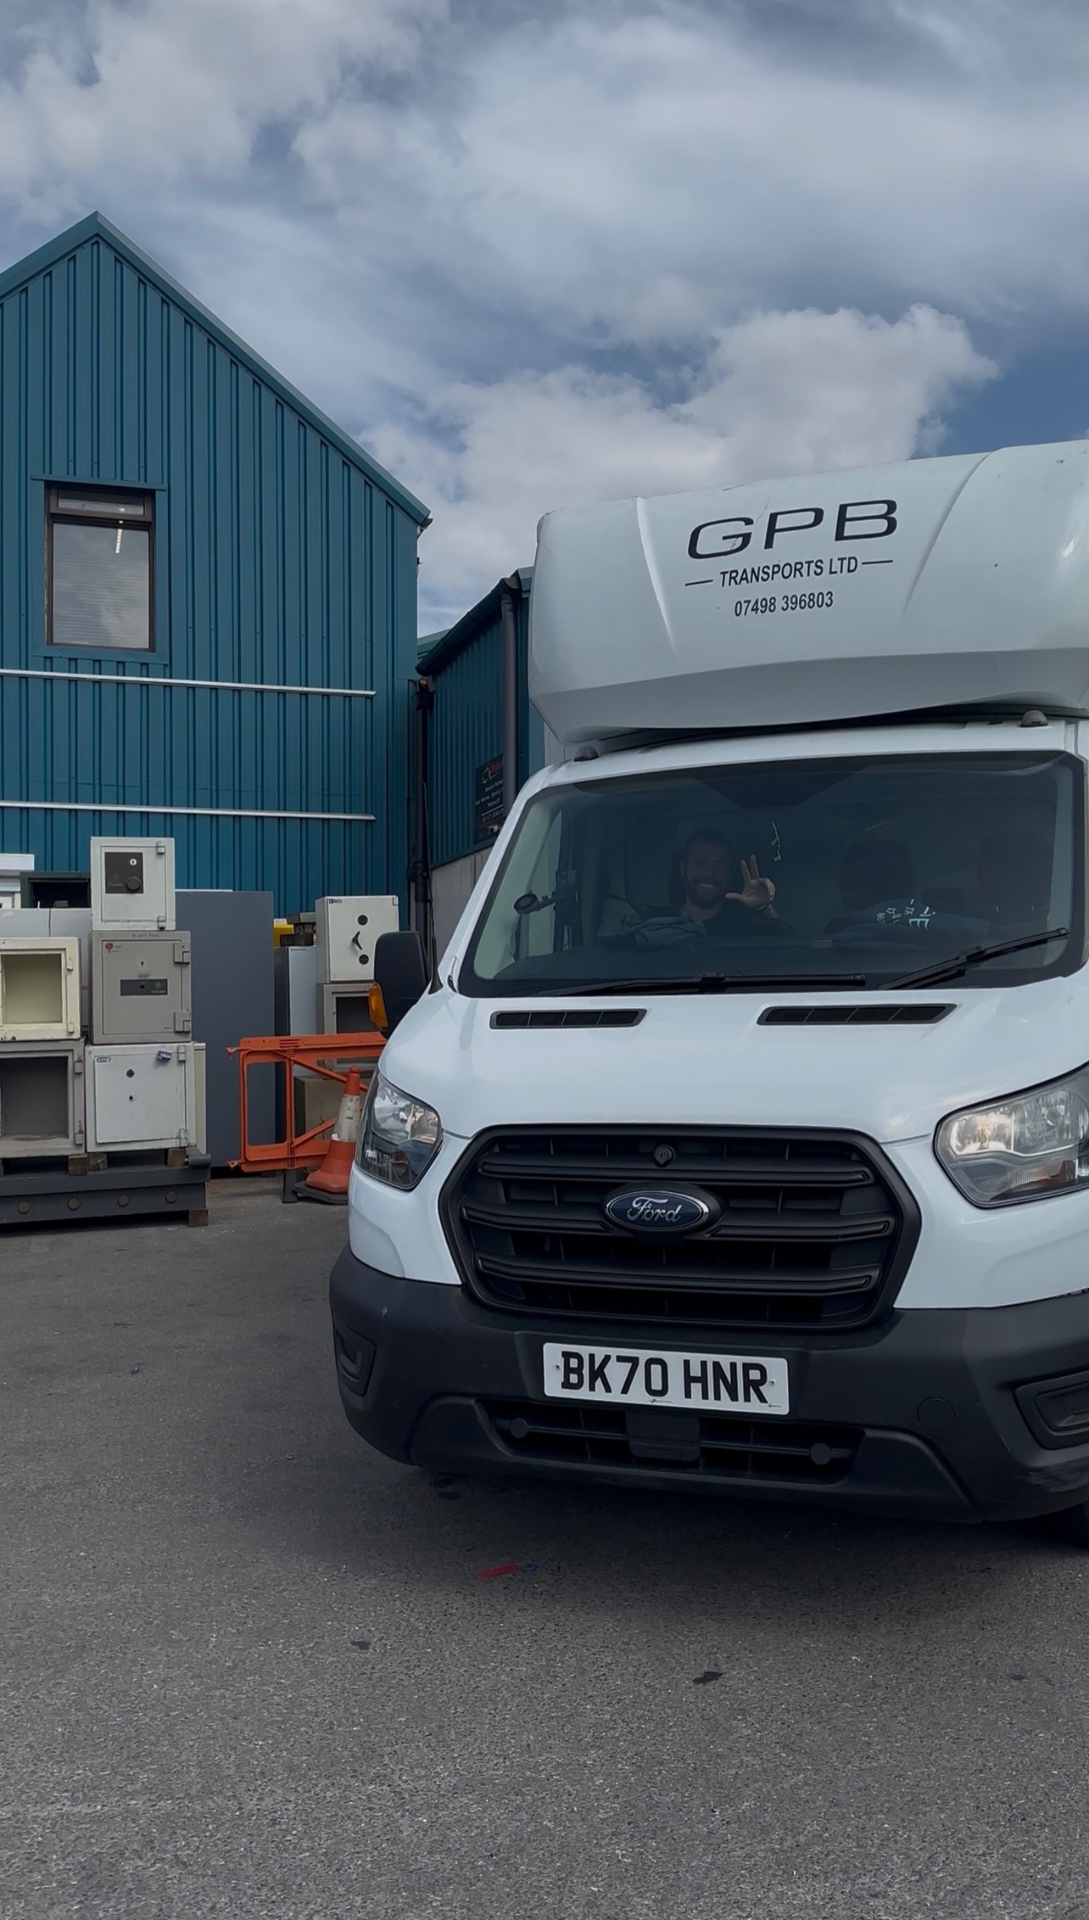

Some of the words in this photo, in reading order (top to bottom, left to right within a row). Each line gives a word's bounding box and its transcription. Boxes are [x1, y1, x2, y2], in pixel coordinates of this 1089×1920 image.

[687, 499, 898, 560] GPB
[719, 559, 824, 587] TRANSPORTS
[829, 556, 859, 575] LTD
[734, 596, 777, 617] 07498
[781, 591, 834, 612] 396803
[626, 1196, 682, 1223] Ford
[561, 1350, 668, 1397] BK70
[683, 1359, 769, 1404] HNR
